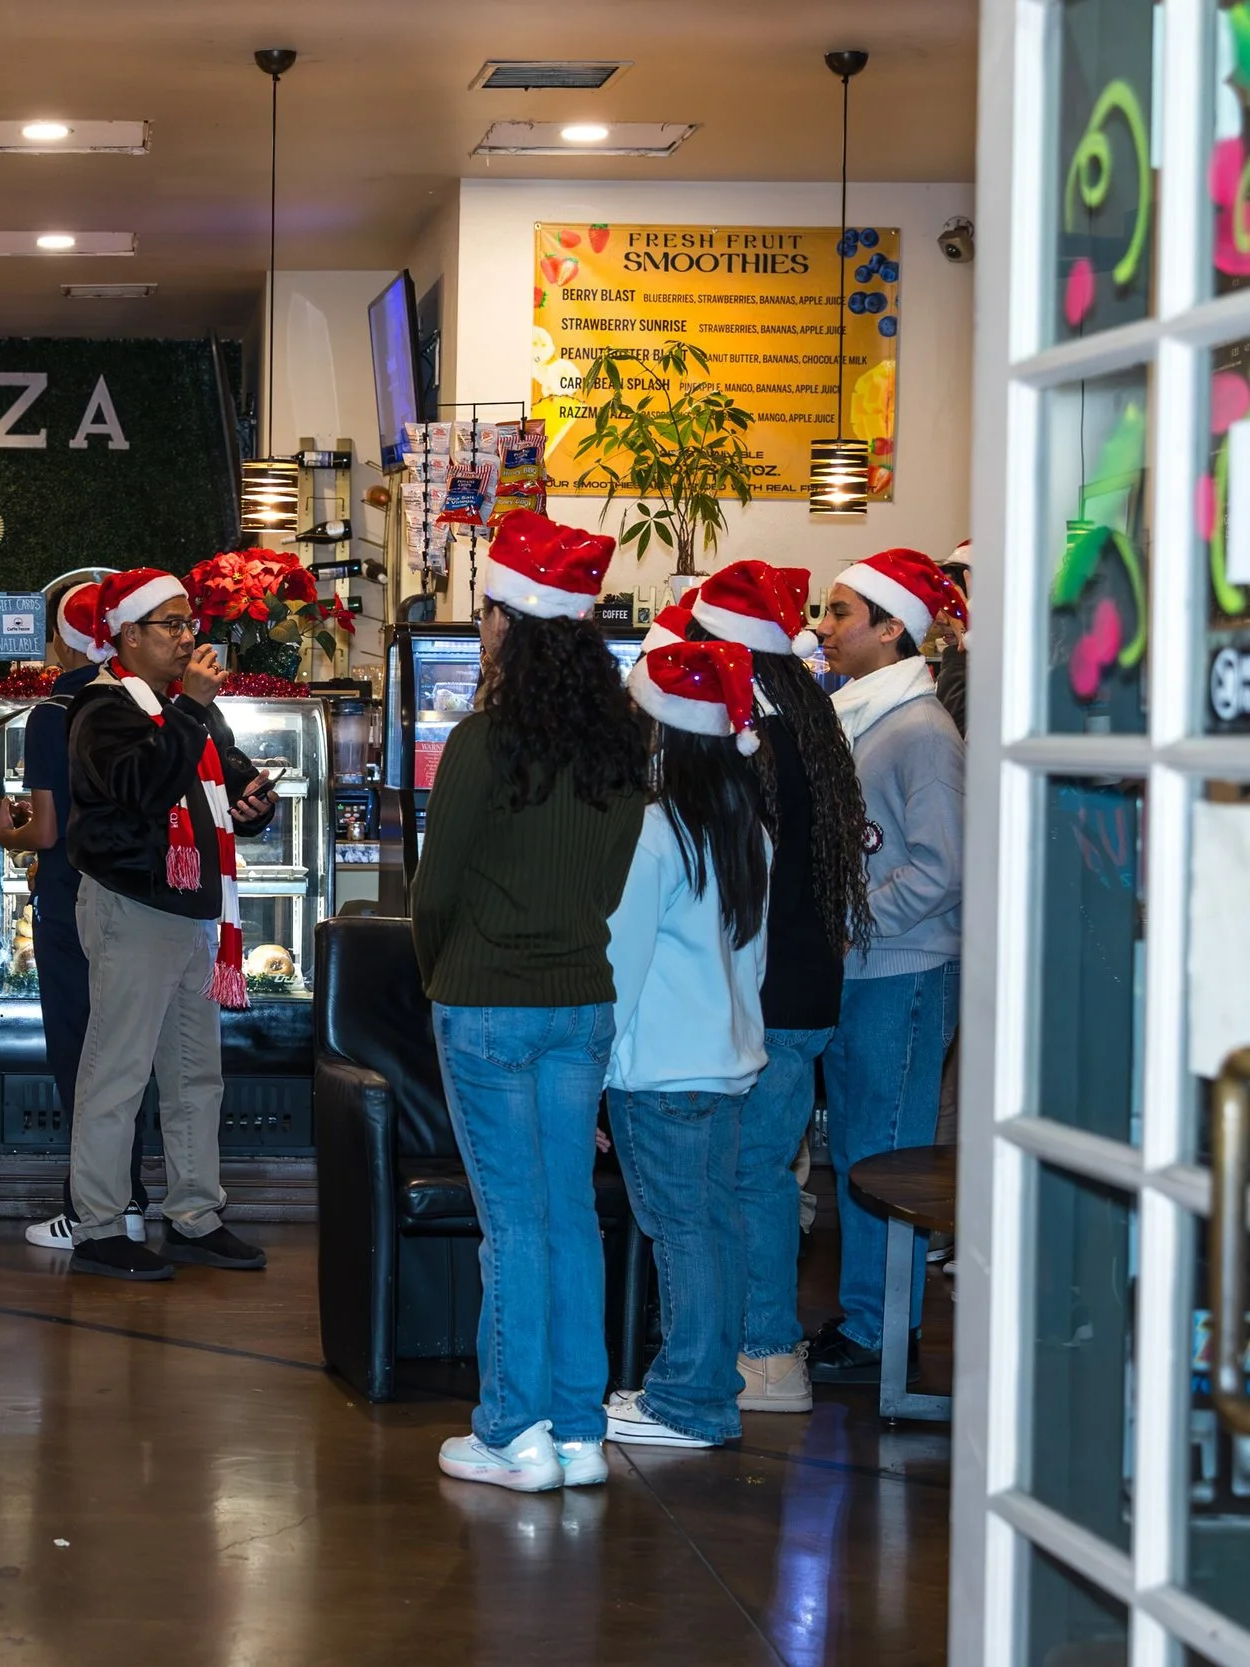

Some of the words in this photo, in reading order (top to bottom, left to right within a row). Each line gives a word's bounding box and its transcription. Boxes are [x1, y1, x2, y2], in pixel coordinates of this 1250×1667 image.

[629, 233, 713, 248] FRESH
[727, 234, 803, 249] FRUIT
[623, 251, 809, 274] SMOOTHIES
[562, 288, 598, 301] BERRY
[601, 289, 636, 302] BLAST
[643, 293, 696, 304] BLUEBERRIES,
[697, 294, 758, 305] STRAWBERRIES,
[759, 295, 798, 305] BANANAS,
[798, 296, 823, 305] APPLE
[824, 296, 846, 306] JUICE
[561, 318, 637, 331] STRAWBERRY
[639, 319, 687, 332] SUNRISE
[698, 324, 759, 334] STRAWBERRIES,
[760, 325, 799, 335] BANANAS,
[800, 325, 823, 335] APPLE
[824, 326, 846, 335] JUICE
[560, 347, 604, 360] PEANUT
[607, 348, 650, 361] TER
[653, 349, 688, 361] BLT
[700, 353, 727, 363] ANUT
[729, 353, 761, 364] BUTTER,
[762, 354, 801, 365] BANANAS,
[848, 355, 867, 365] MILK
[627, 378, 670, 391] SPLASH
[724, 383, 754, 393] MANGO,
[756, 384, 794, 394] BANANAS,
[795, 384, 819, 394] APPLE
[559, 406, 631, 420] RAZZMAZZ
[757, 412, 788, 423] MANGO,
[789, 413, 812, 423] APPLE
[813, 414, 835, 423] JUICE
[766, 484, 796, 492] REAL
[16, 599, 41, 611] CARDS
[602, 610, 628, 619] COFFEE
